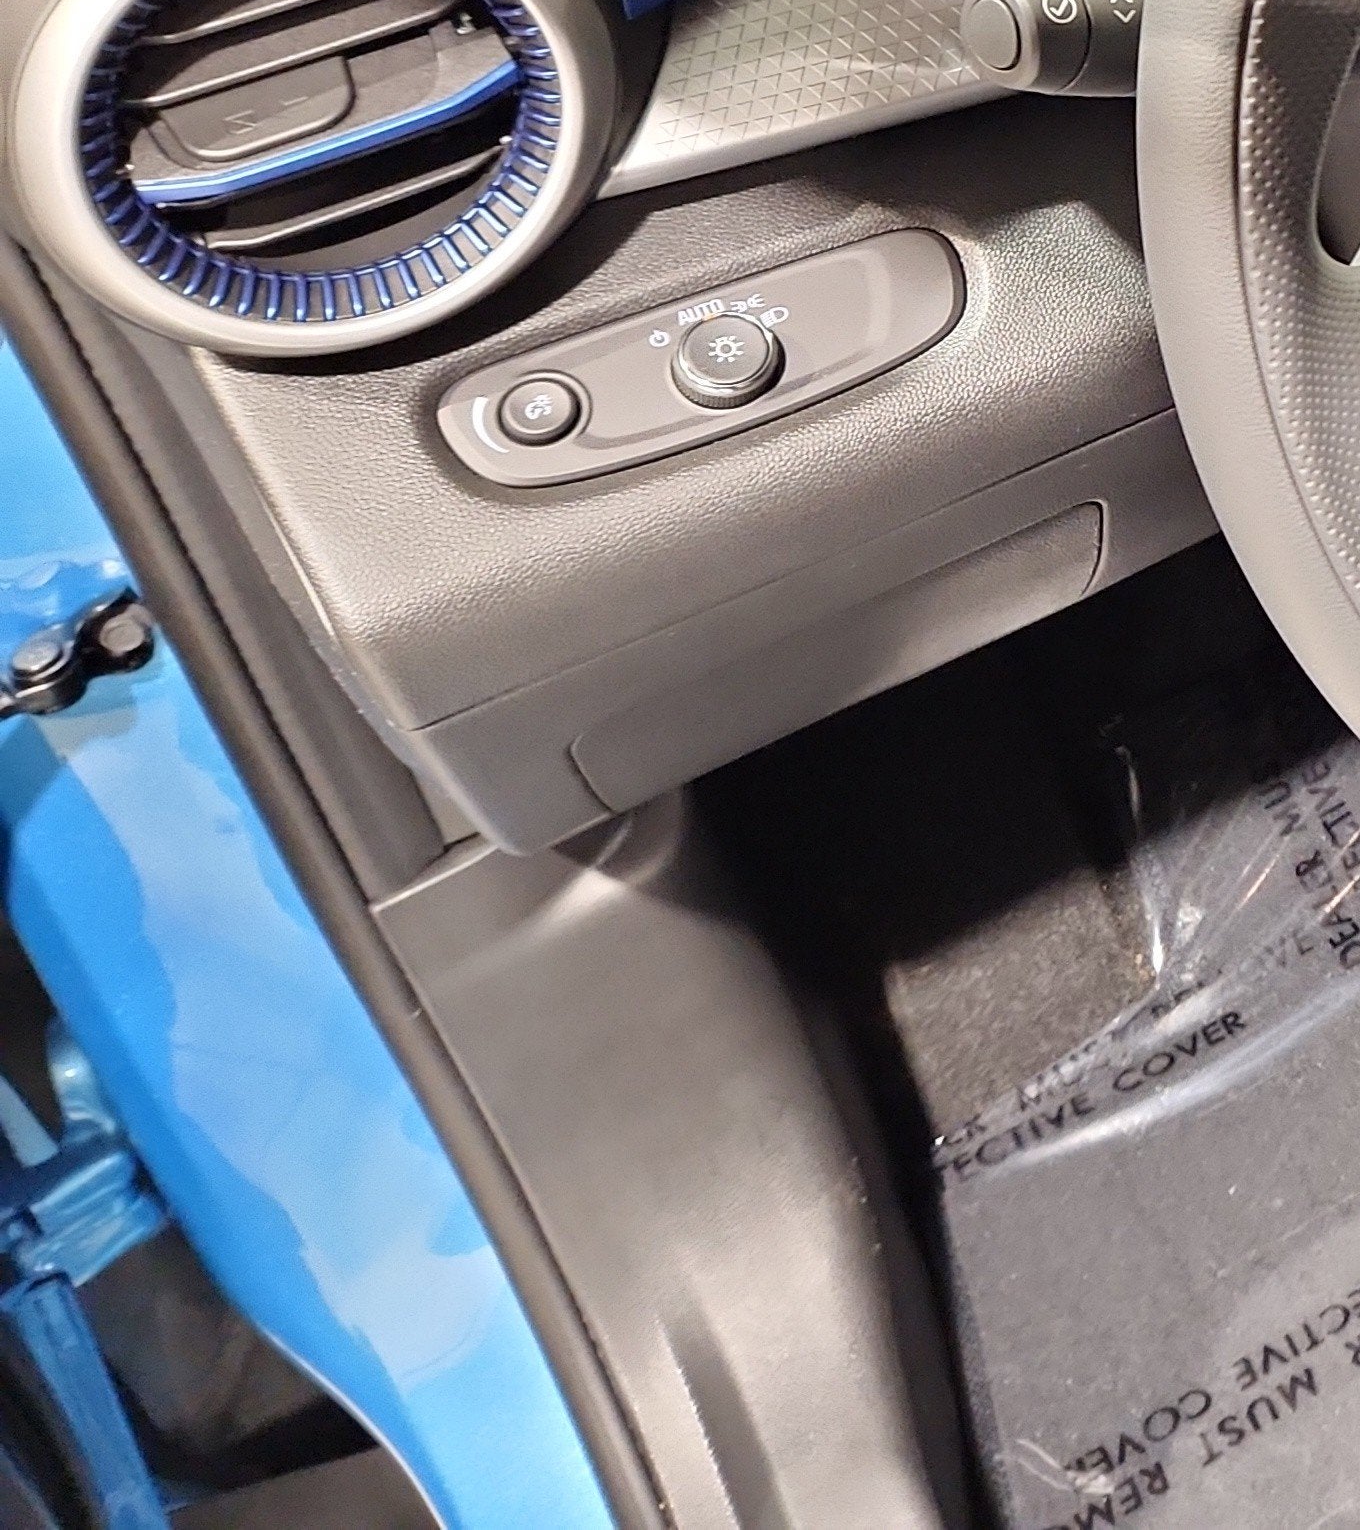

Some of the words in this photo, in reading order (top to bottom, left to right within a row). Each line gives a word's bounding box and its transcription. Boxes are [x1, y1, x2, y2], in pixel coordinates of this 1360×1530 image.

[677, 298, 725, 327] AUTO
[1110, 1008, 1248, 1094] COVER
[1200, 1366, 1321, 1469] MUST
